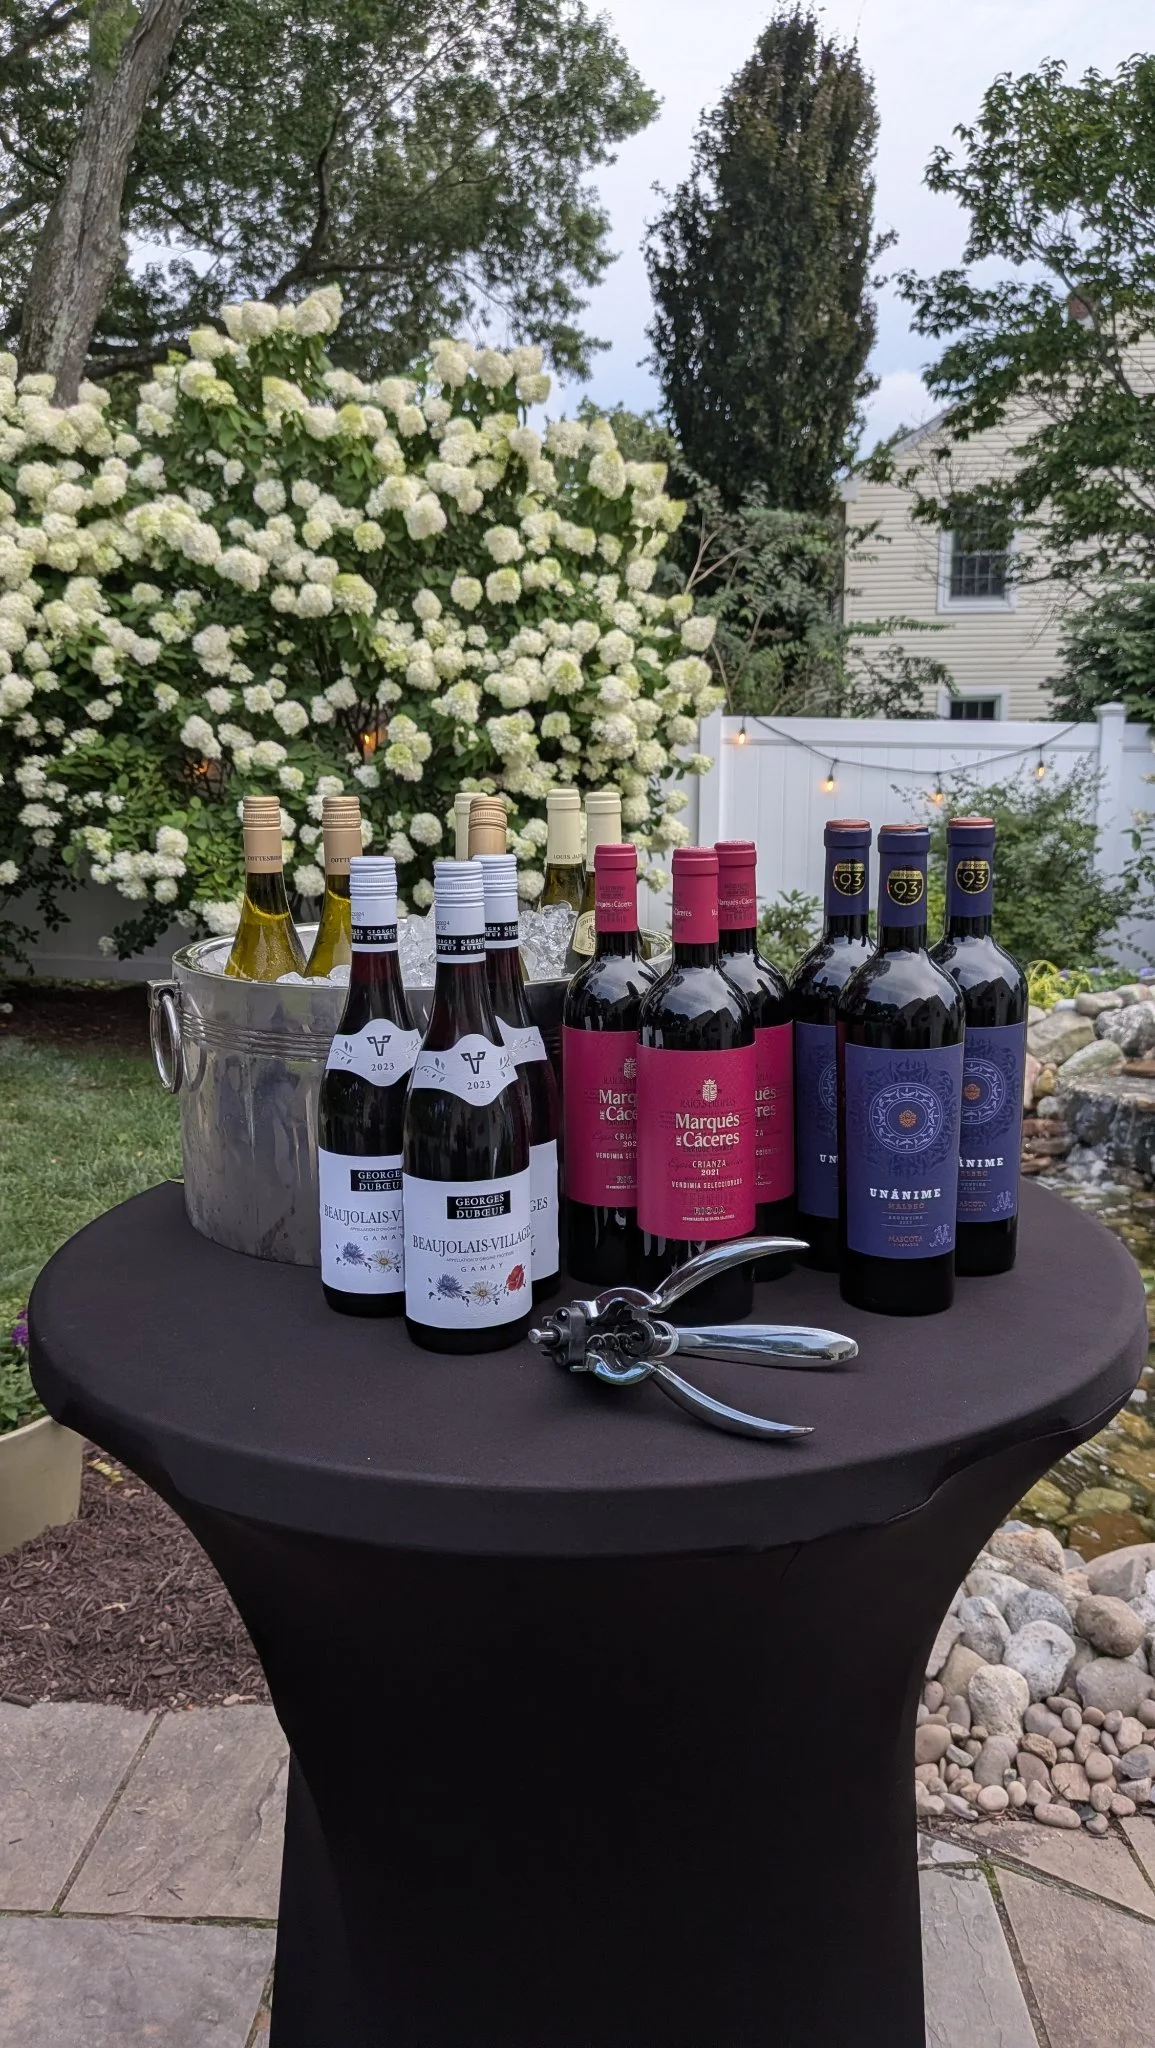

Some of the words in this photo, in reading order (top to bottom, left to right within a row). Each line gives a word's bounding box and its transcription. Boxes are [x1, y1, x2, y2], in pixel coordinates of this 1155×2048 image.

[840, 873, 862, 890] 93
[962, 871, 985, 887] 93
[894, 881, 918, 899] 93
[370, 1062, 395, 1072] 2023
[467, 1080, 491, 1090] 2023
[600, 1089, 638, 1107] Marq
[606, 1105, 638, 1121] Cáce
[675, 1112, 740, 1133] Marqués
[682, 1132, 740, 1148] Cáceres
[692, 1160, 727, 1168] CRIANZA
[358, 1170, 401, 1180] GEORGE
[700, 1168, 720, 1176] 2021
[358, 1181, 401, 1191] DUBŒU
[672, 1180, 701, 1189] VENDIMIA
[456, 1193, 504, 1206] GEORGES
[869, 1187, 942, 1200] UNÁNIME
[324, 1204, 403, 1226] BEAUJOLAIS-V
[456, 1206, 504, 1219] DUBŒUF
[412, 1222, 531, 1257] BEAUJOLAIS-VILLAGE
[460, 1262, 503, 1273] GAMAY
